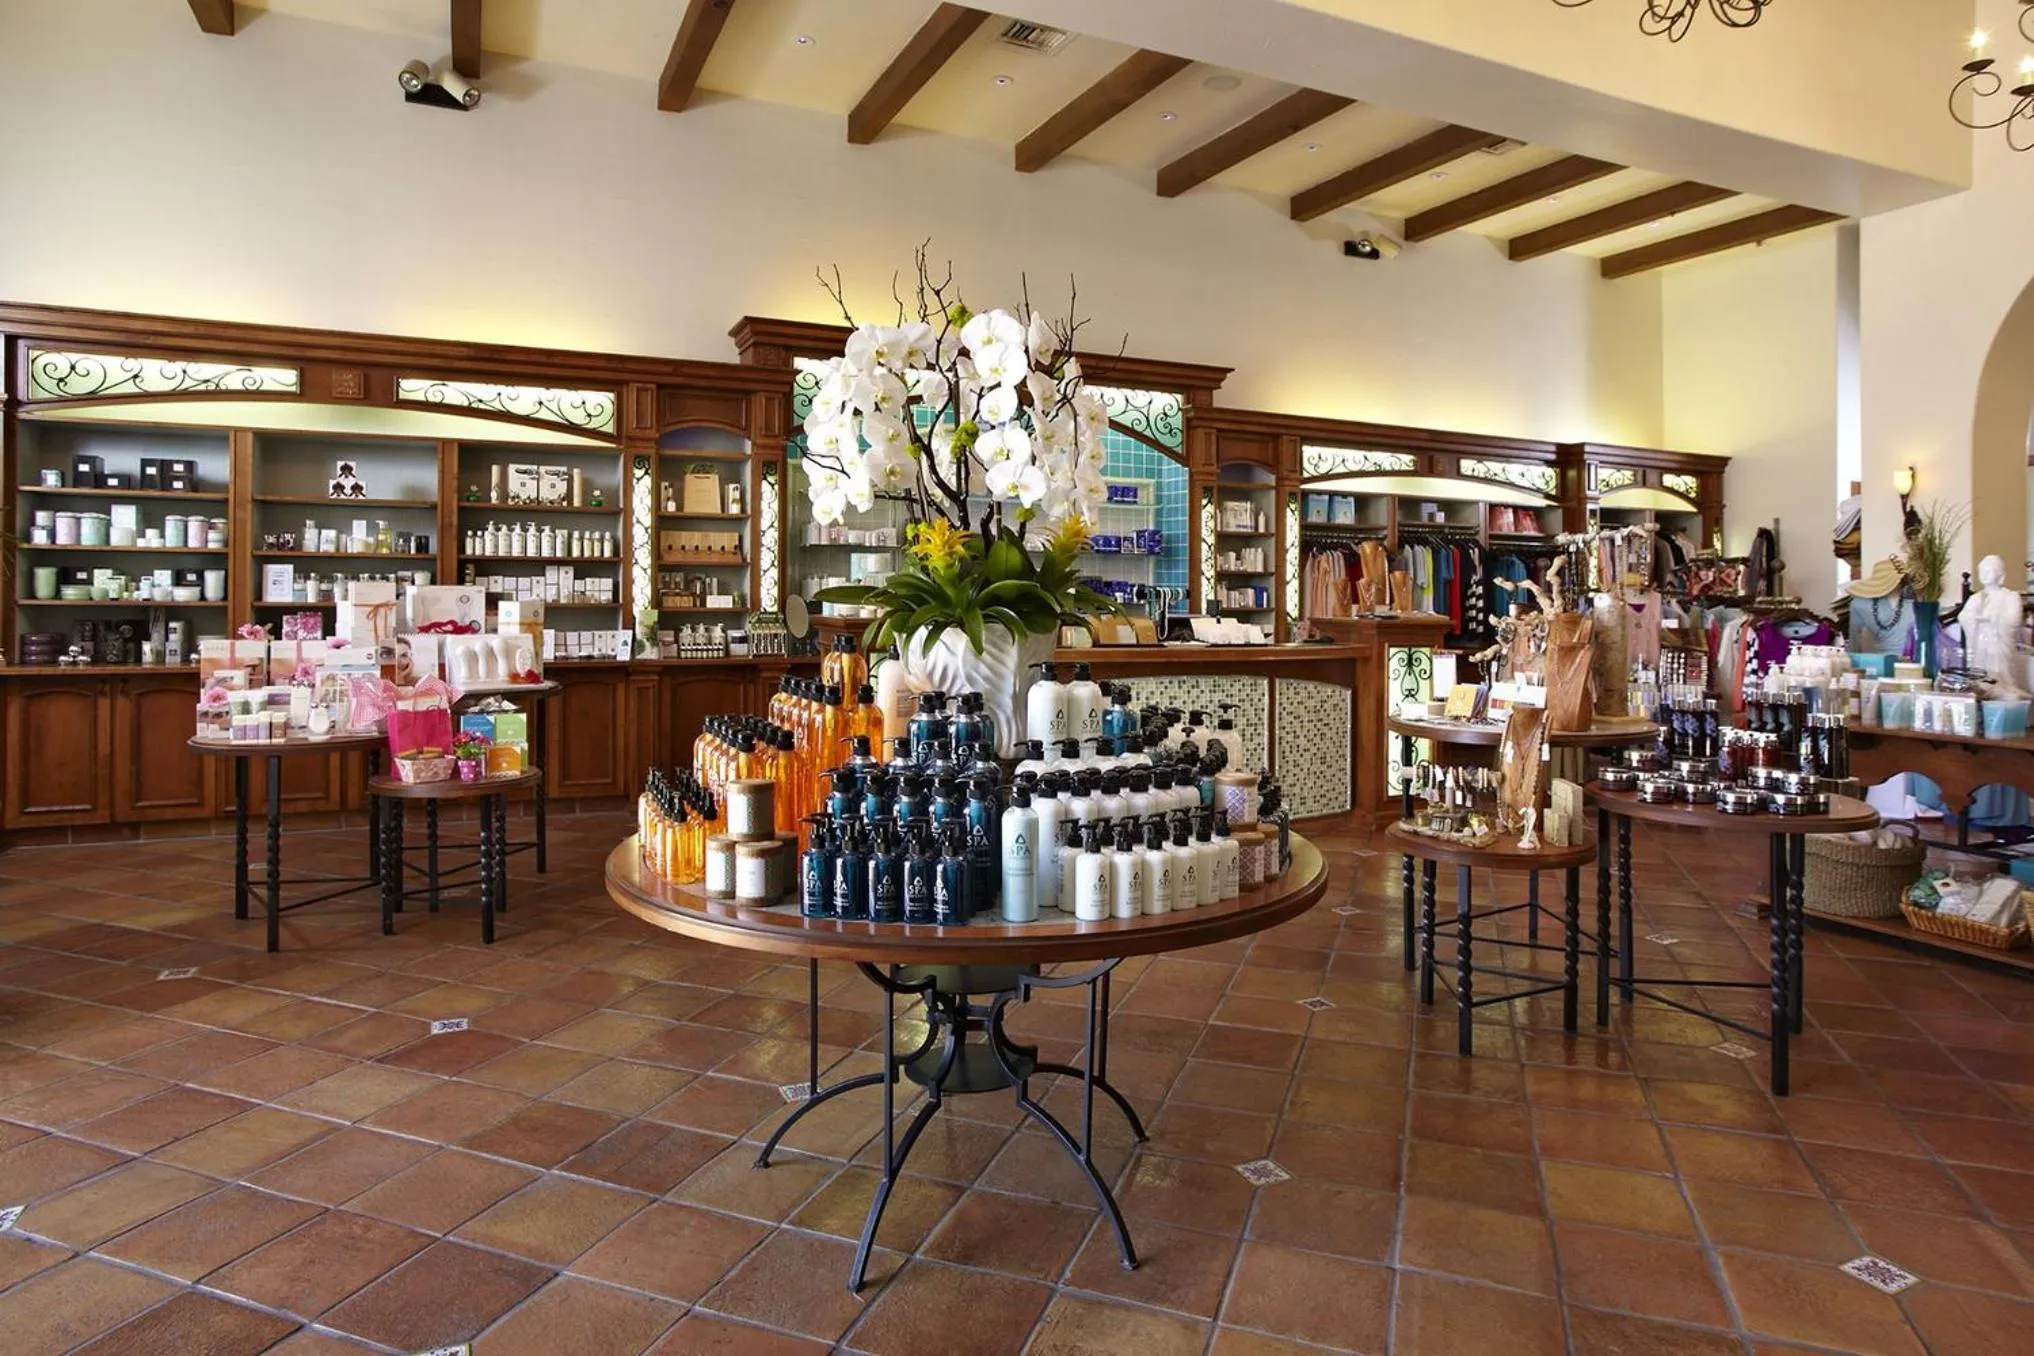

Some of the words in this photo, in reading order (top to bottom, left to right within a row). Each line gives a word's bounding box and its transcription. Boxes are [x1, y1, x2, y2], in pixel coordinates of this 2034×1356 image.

[967, 836, 989, 846] SPA
[1010, 845, 1031, 856] SPA
[877, 884, 896, 893] SPA
[909, 885, 927, 894] SPA
